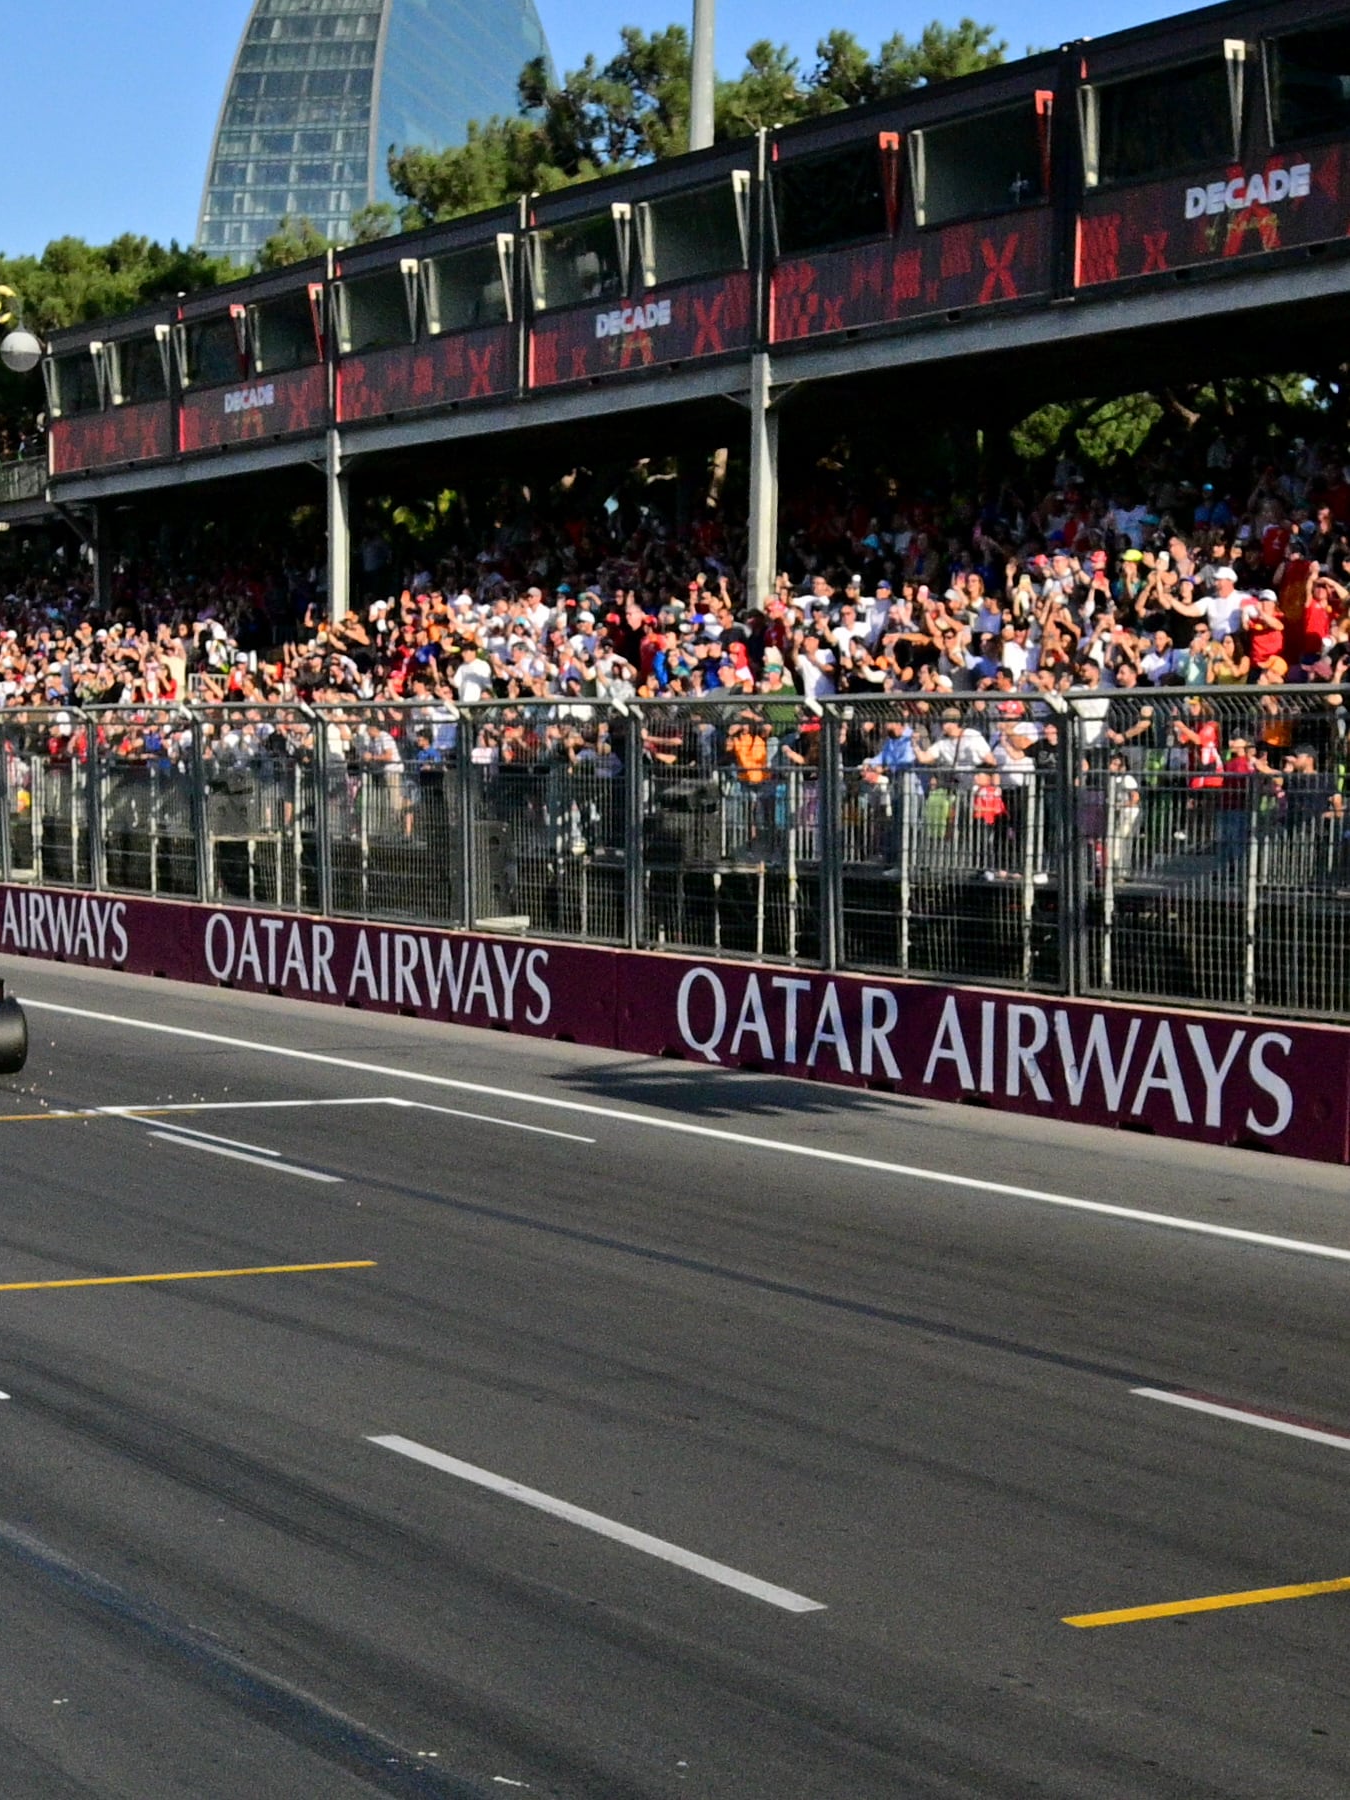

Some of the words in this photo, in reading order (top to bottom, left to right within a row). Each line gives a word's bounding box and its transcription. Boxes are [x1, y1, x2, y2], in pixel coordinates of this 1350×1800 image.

[1185, 163, 1311, 220] DECADE
[595, 299, 671, 338] DECADE
[224, 383, 275, 414] DECADE
[2, 889, 128, 963] AIRWAYS
[204, 912, 337, 995] QATAR
[348, 929, 551, 1026] AIRWAYS
[676, 967, 902, 1080] QATAR
[923, 995, 1293, 1136] AIRWAYS
